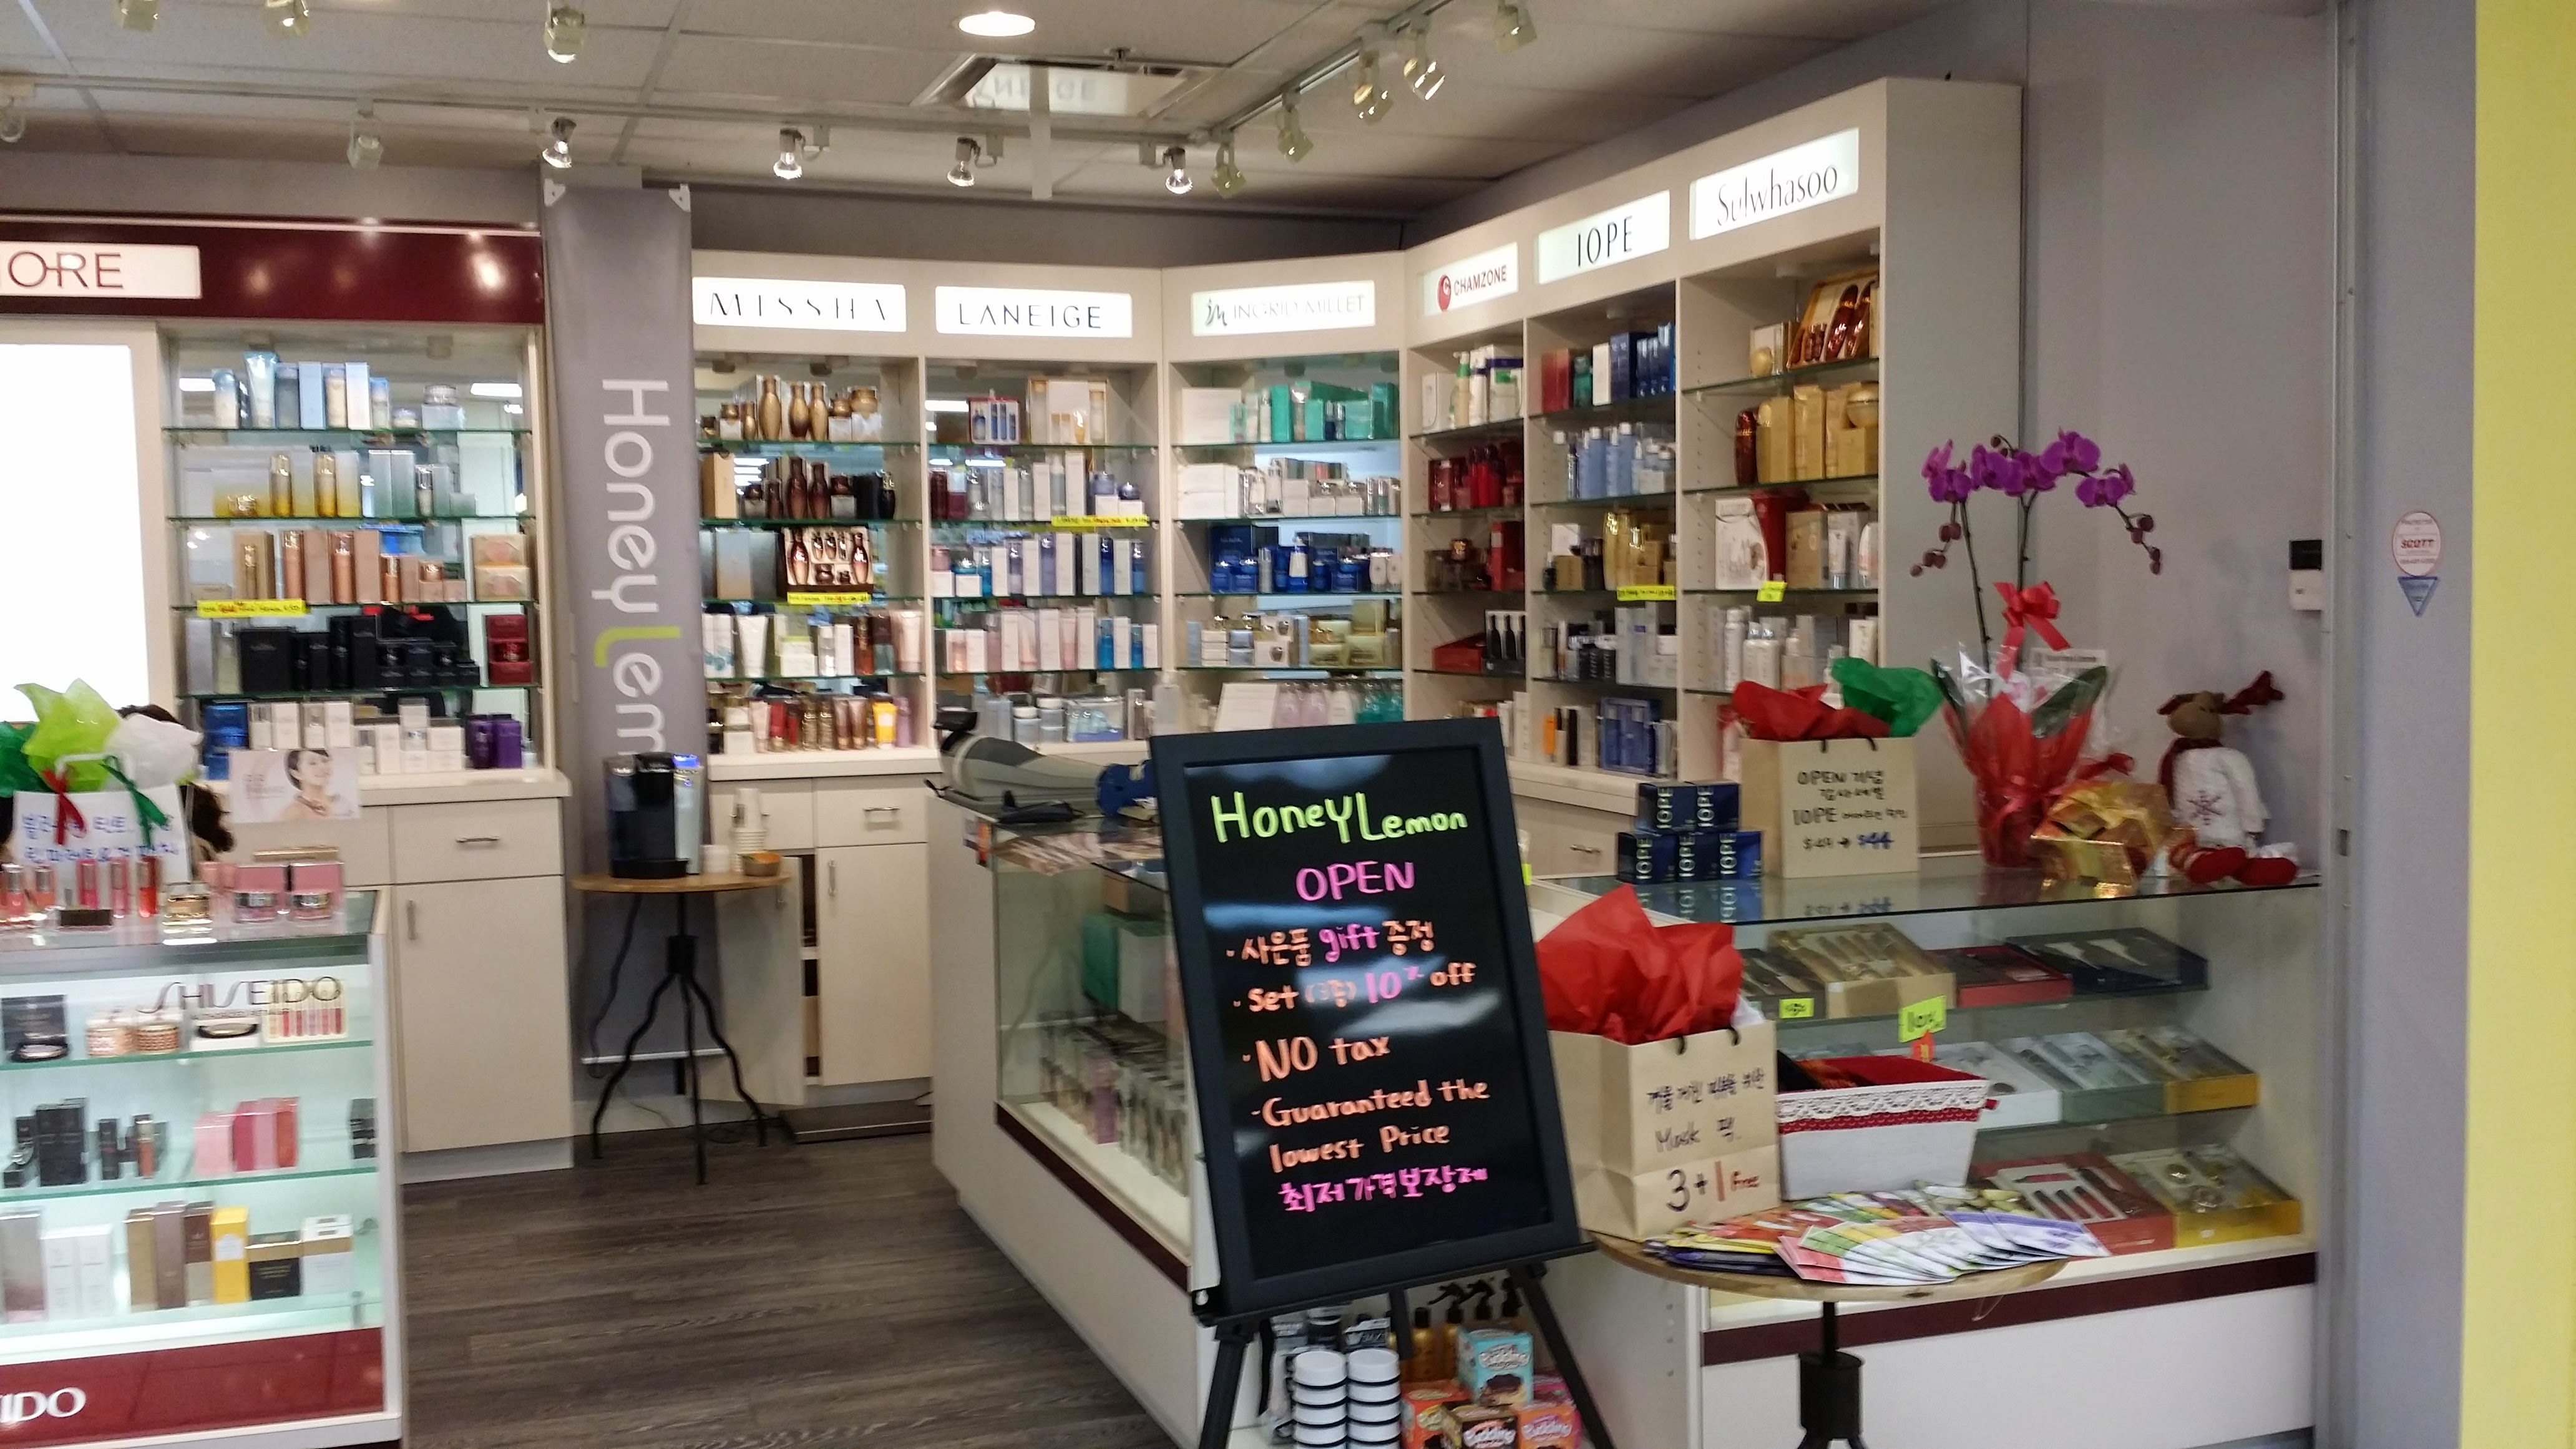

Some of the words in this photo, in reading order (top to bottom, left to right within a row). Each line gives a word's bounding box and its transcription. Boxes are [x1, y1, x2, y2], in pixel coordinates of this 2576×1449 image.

[1717, 165, 1837, 225] Sulwhasoo
[1577, 216, 1633, 267] IOPE
[1453, 265, 1507, 296] CHAMZONE
[711, 292, 886, 321] MISSHA
[959, 303, 1101, 329] LANEIGE
[2401, 539, 2434, 549] SCOTT
[1797, 769, 1847, 785] OPEN
[1656, 787, 1674, 829] IOPE
[1696, 786, 1715, 827] IOPE
[1793, 807, 1837, 826] IOPE
[1636, 837, 1653, 880] IOPE
[1679, 834, 1695, 877] IOPE
[1719, 832, 1737, 875] IOPE
[1295, 860, 1415, 901] OPEN
[1241, 927, 1311, 967] 사은품
[1318, 923, 1380, 962] gift
[1382, 920, 1434, 956] 증정
[136, 975, 341, 1013] SHISEIDO
[1430, 961, 1476, 986] off
[1255, 1036, 1318, 1082] NO
[1328, 1036, 1391, 1065] tax
[1261, 1079, 1433, 1127] Guaranteed
[1437, 1078, 1490, 1101] the
[1269, 1138, 1365, 1173] lowest
[0, 1387, 87, 1423] IDO
